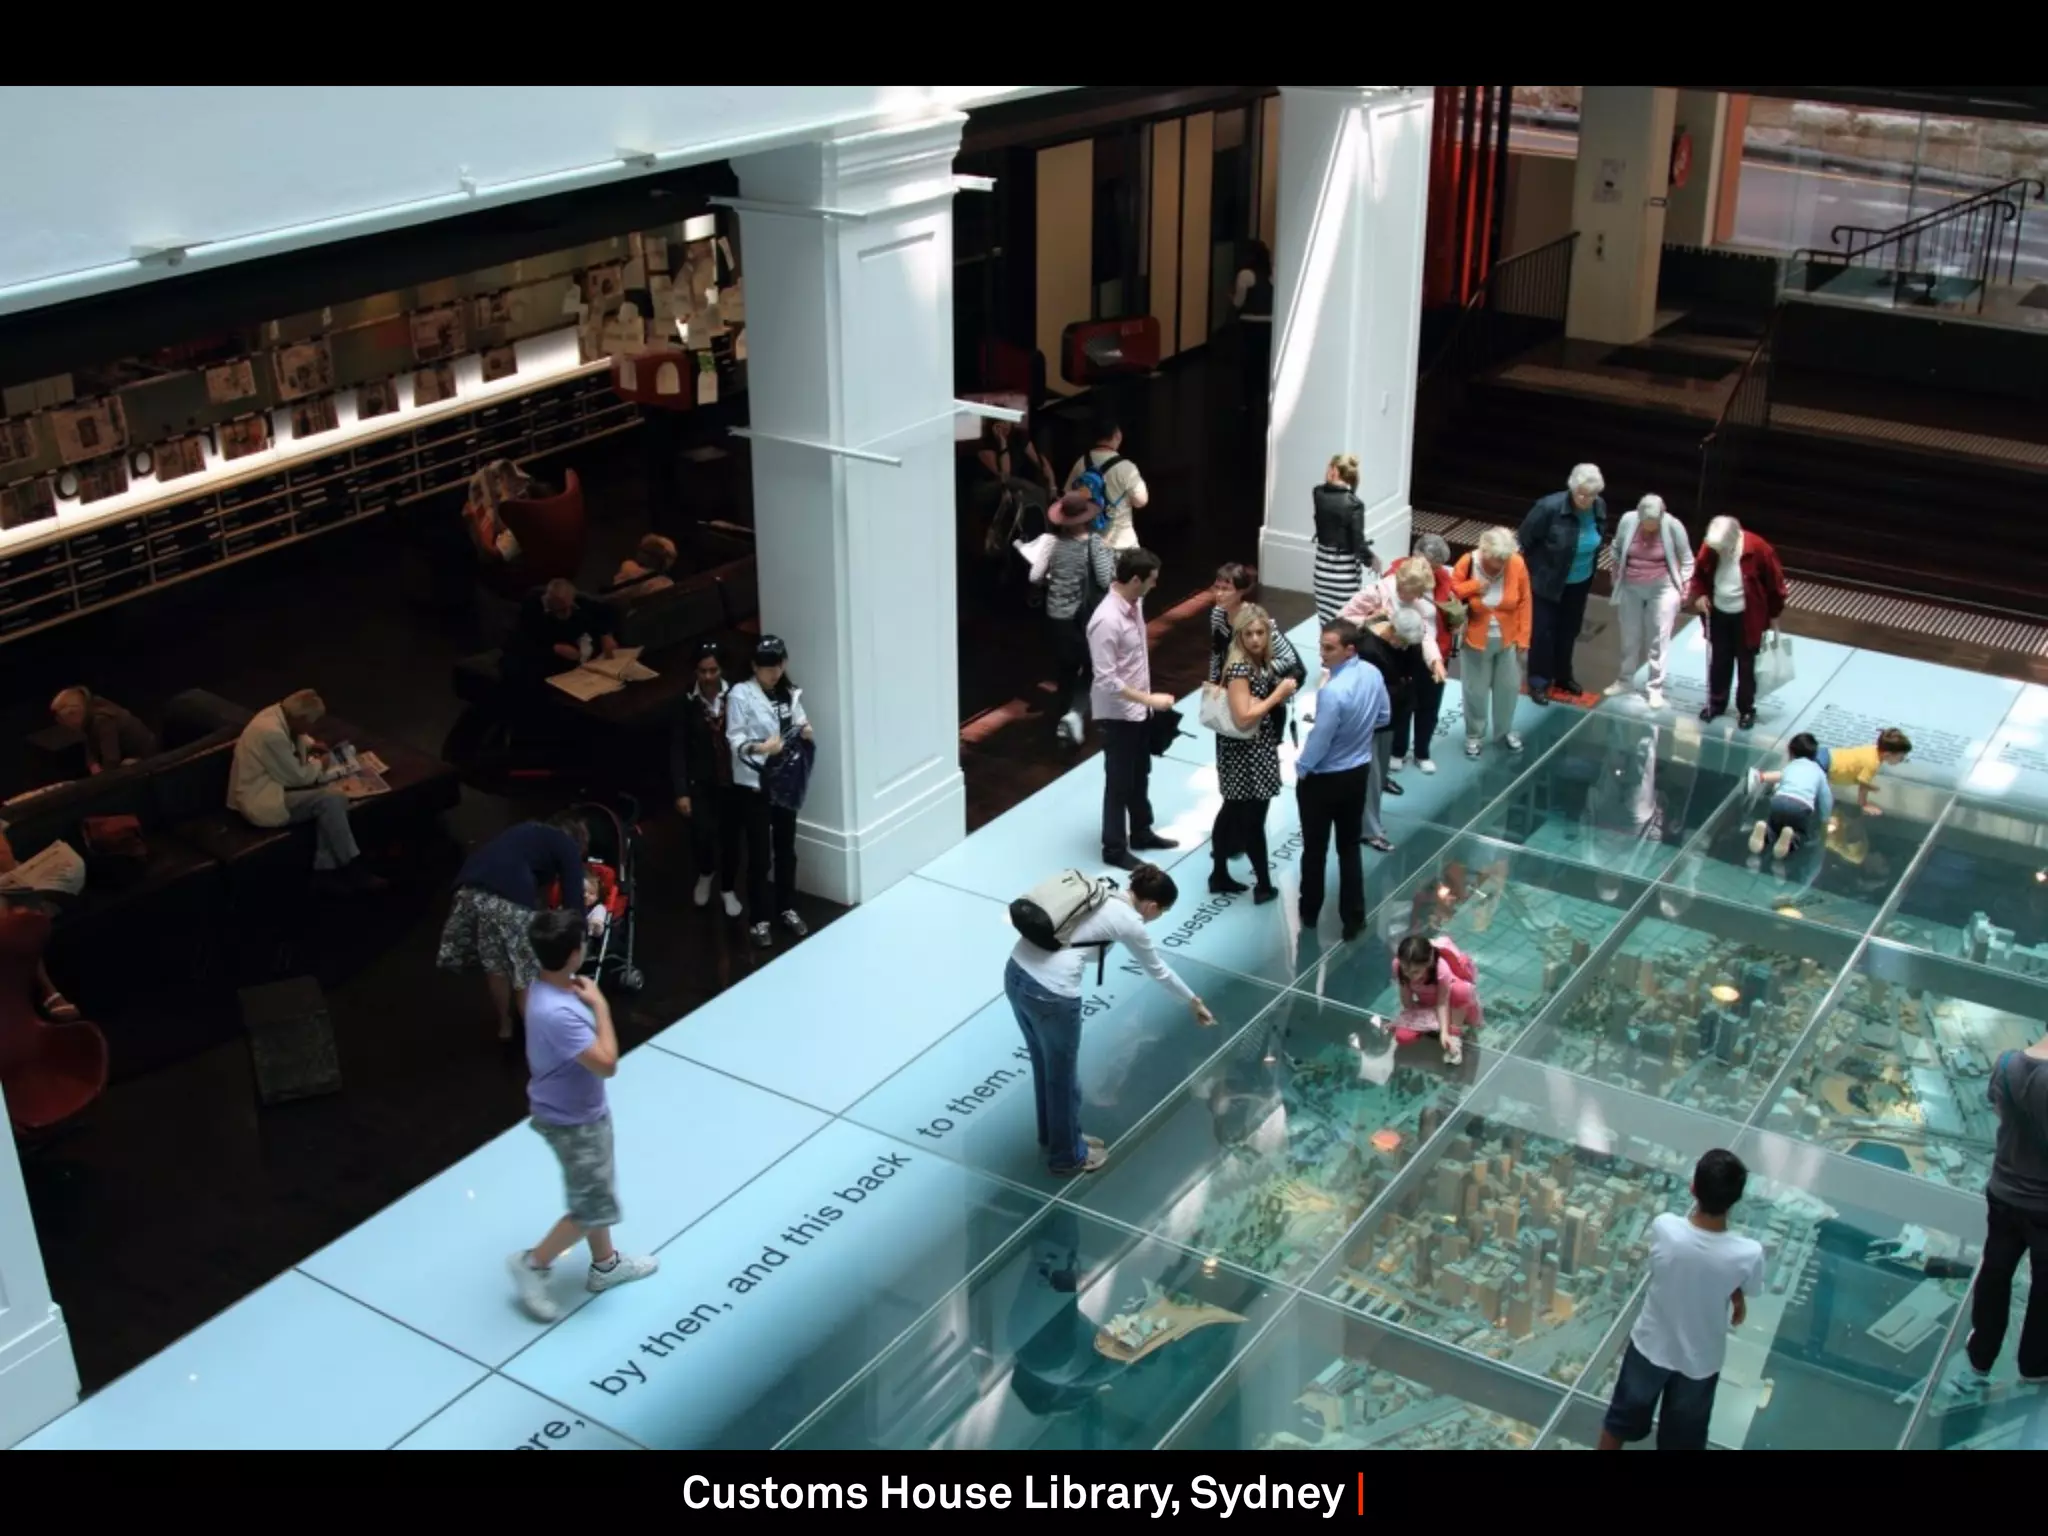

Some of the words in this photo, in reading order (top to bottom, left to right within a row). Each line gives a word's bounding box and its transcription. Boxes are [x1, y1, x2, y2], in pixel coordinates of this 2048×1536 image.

[589, 1360, 647, 1396] by
[640, 1302, 733, 1358] then,
[727, 1246, 790, 1294] and
[780, 1205, 844, 1246] this
[832, 1151, 912, 1204] back
[916, 1118, 954, 1139] to
[945, 1069, 1026, 1115] them,
